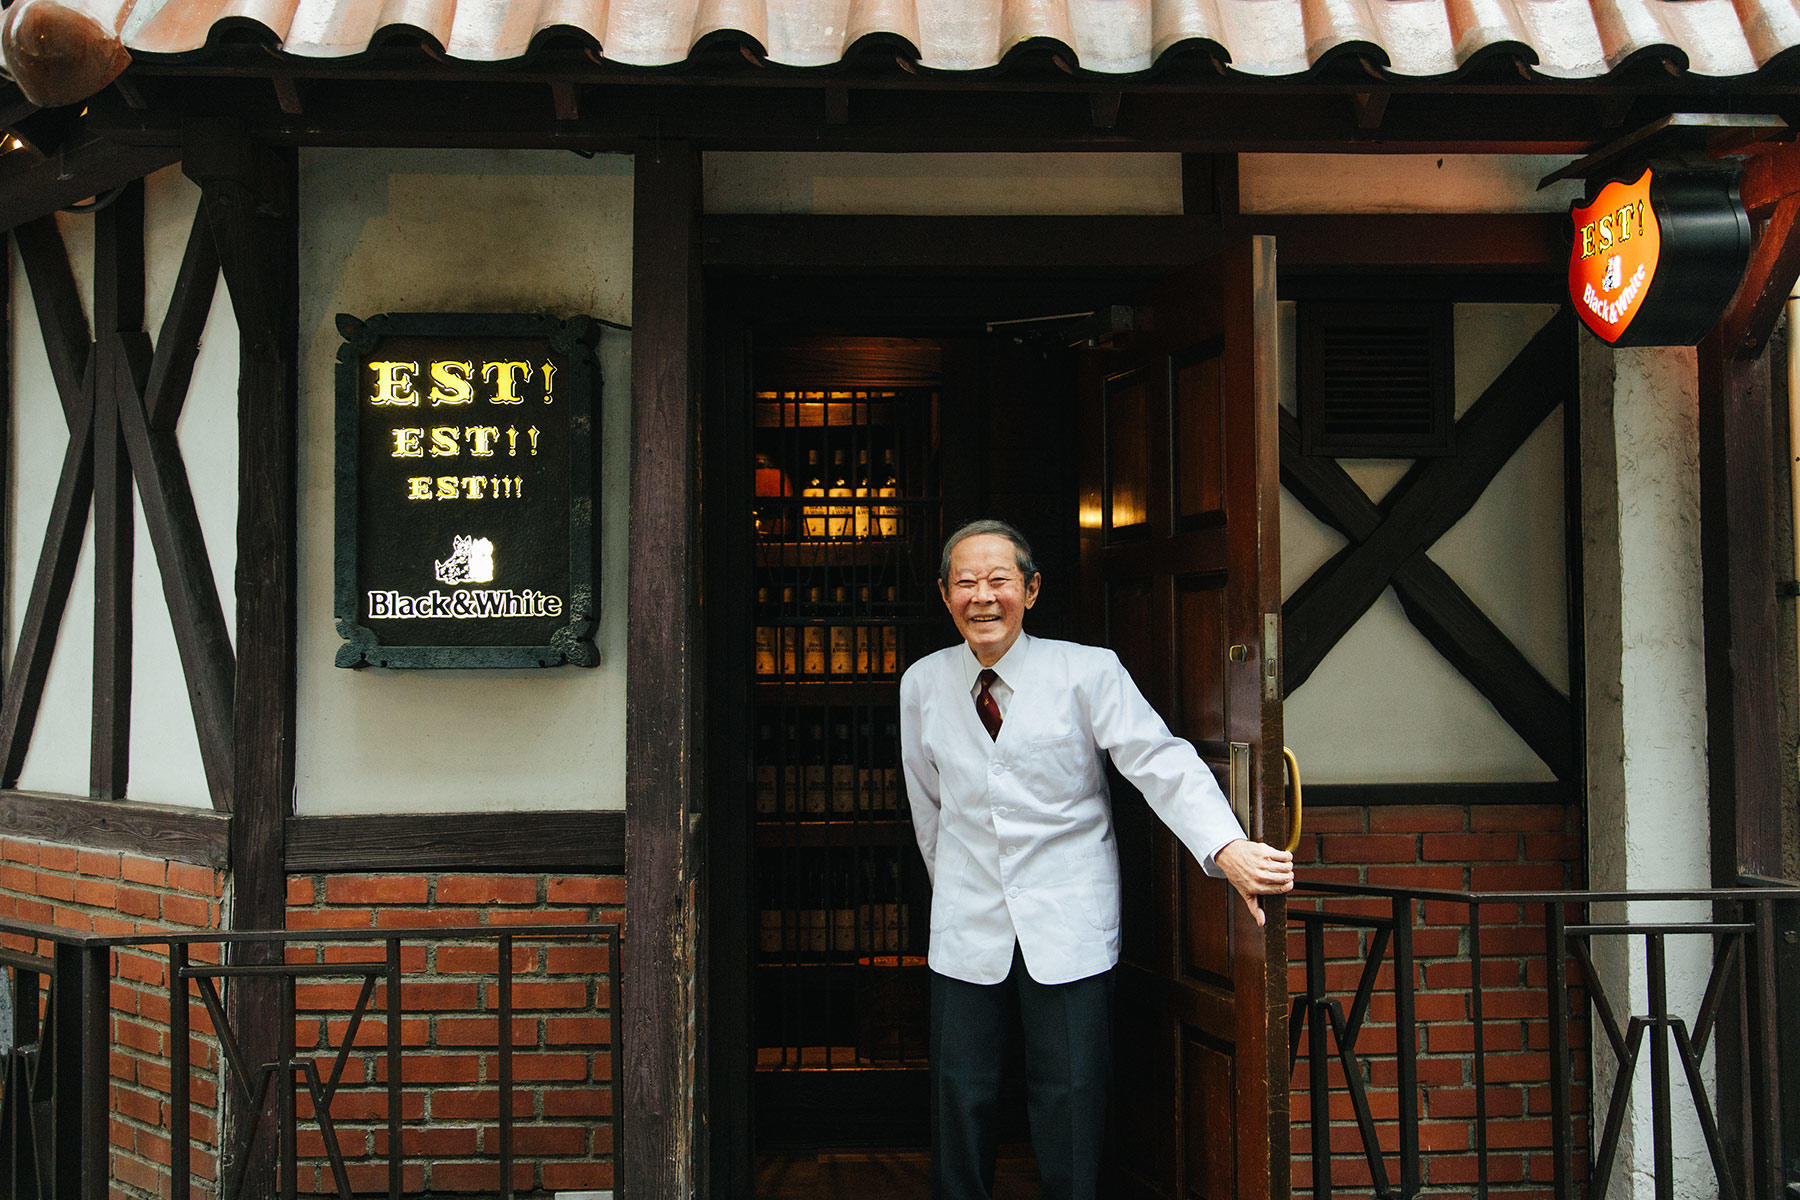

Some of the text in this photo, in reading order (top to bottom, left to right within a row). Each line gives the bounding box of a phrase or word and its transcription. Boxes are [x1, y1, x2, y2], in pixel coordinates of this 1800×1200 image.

[1580, 200, 1644, 259] EST!
[1584, 264, 1645, 324] Black&White
[369, 359, 558, 406] EST!
[391, 426, 539, 457] EST!!
[407, 475, 523, 500] EST!!!
[368, 589, 563, 619] Black&White
